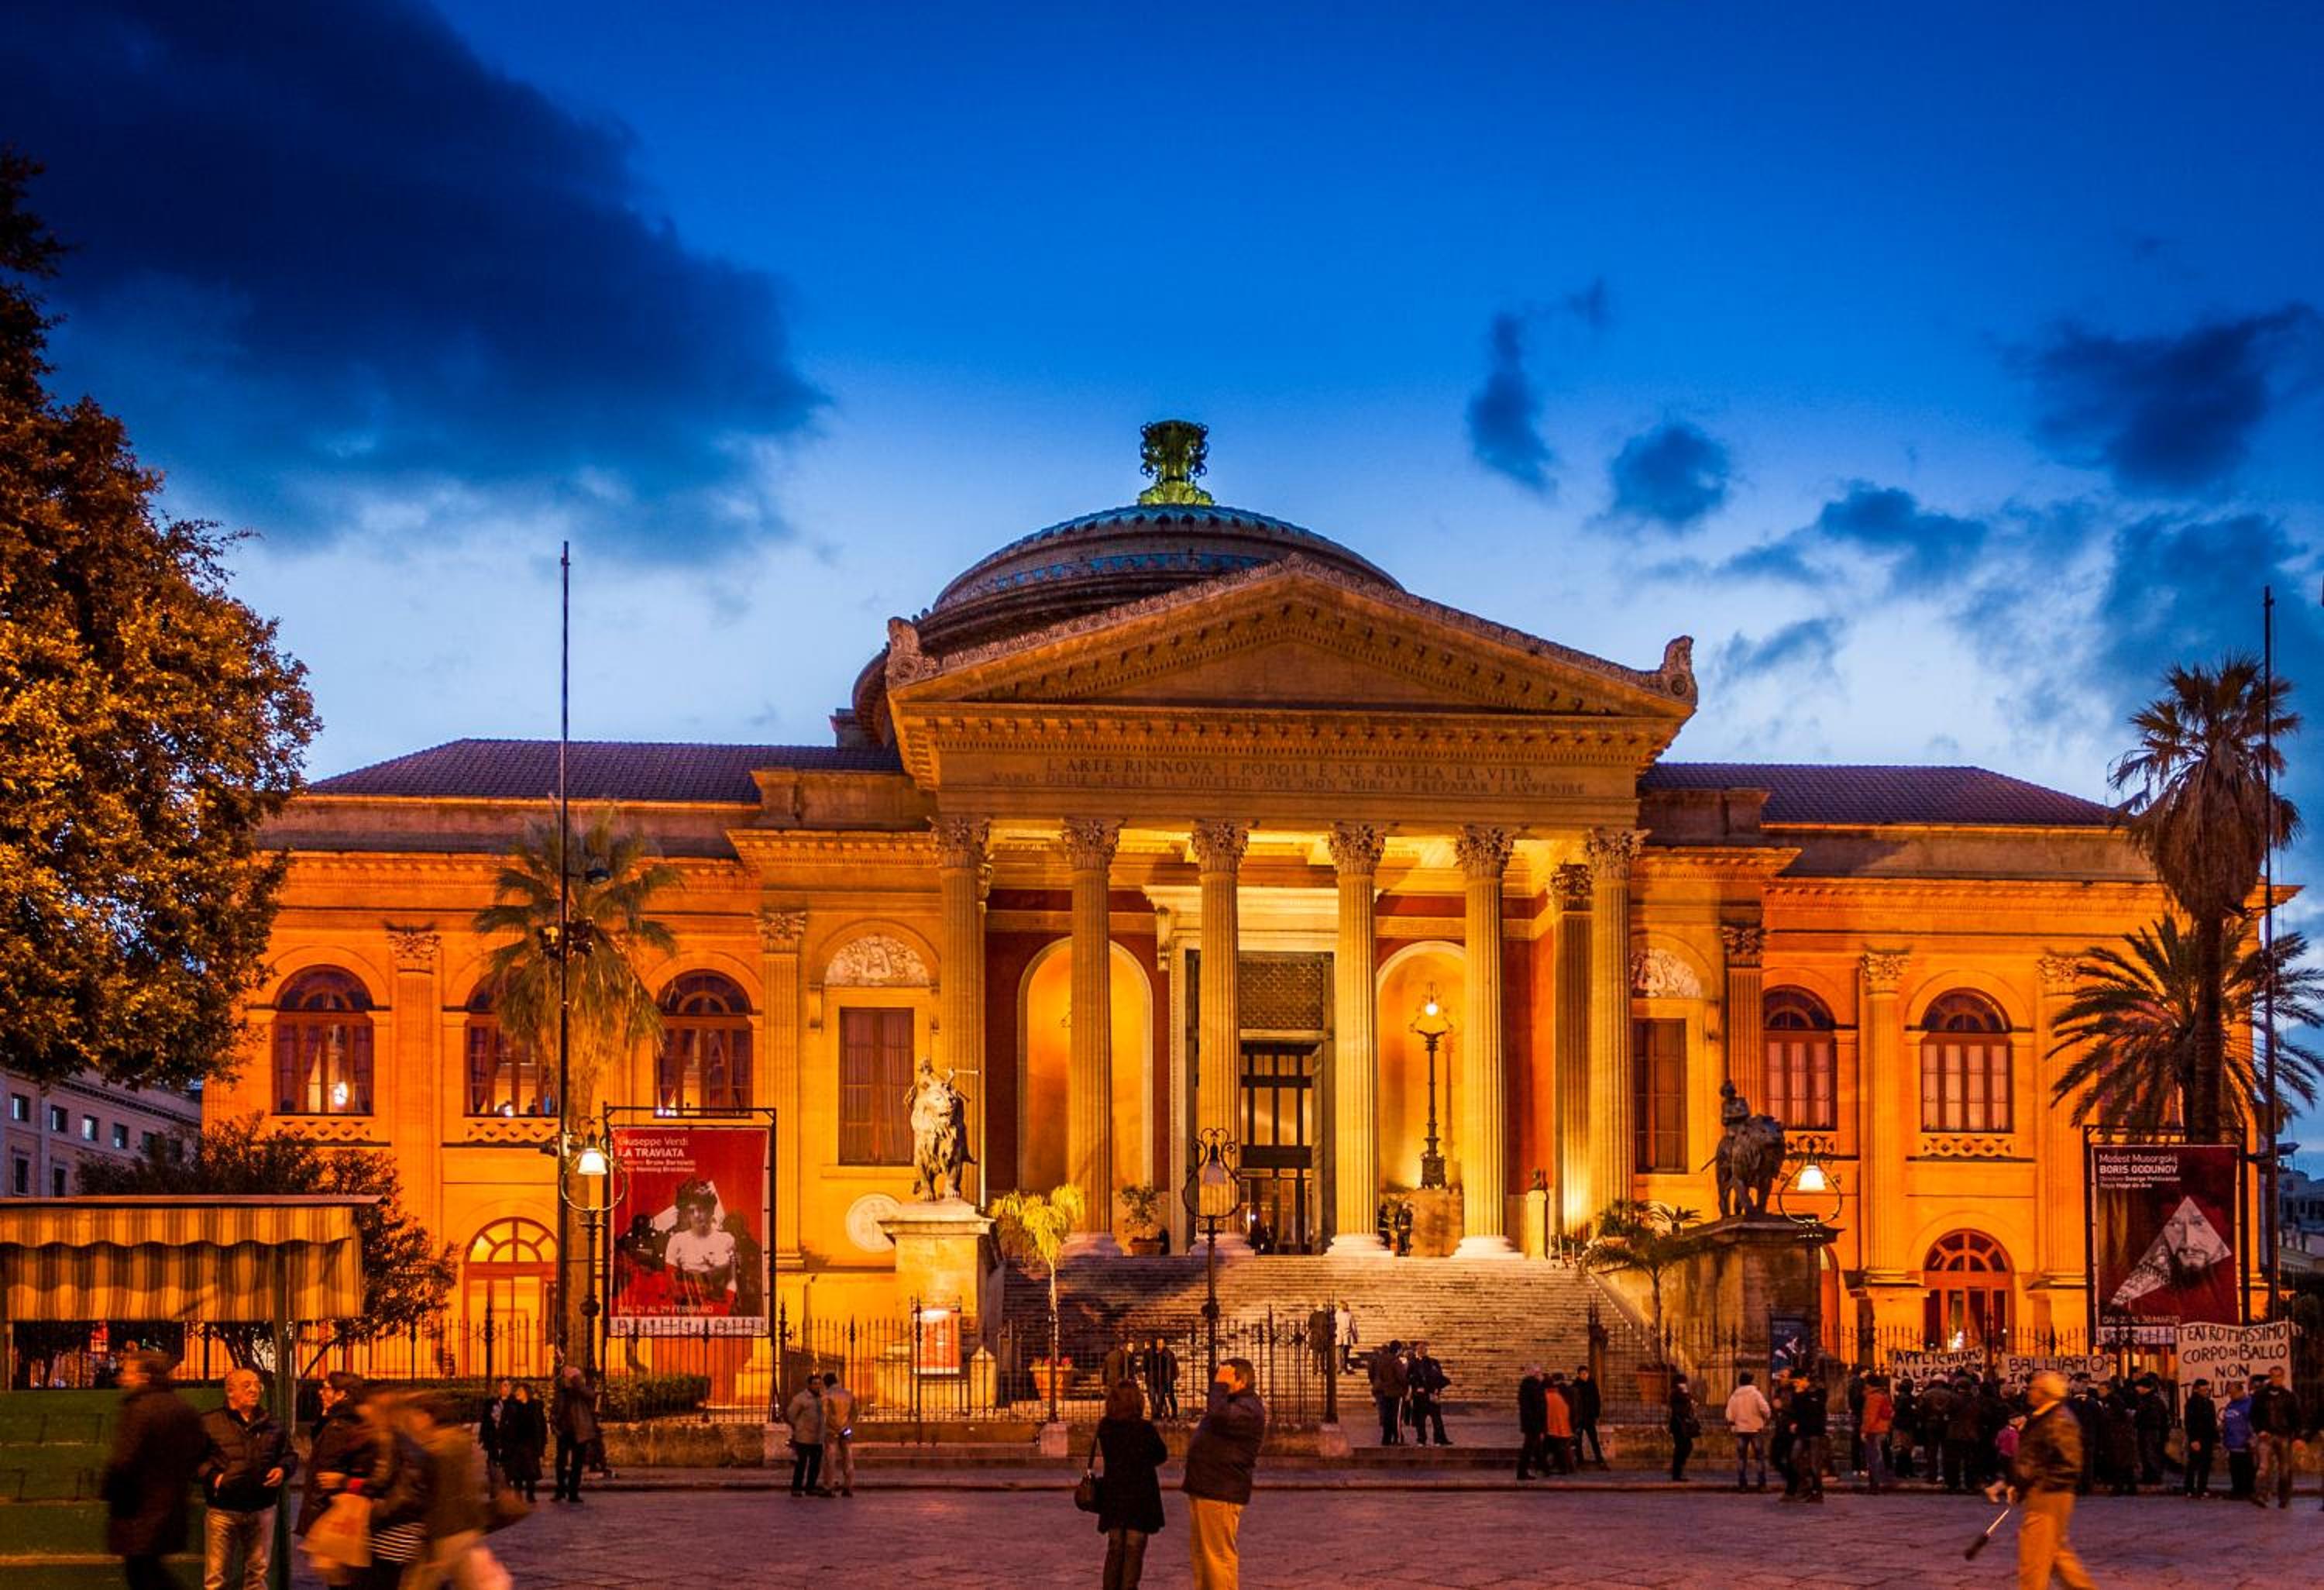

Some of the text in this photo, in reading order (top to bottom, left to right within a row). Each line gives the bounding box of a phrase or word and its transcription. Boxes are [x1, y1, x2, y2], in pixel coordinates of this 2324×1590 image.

[1125, 759, 1214, 774] RINNOVA
[1241, 762, 1308, 777] POPOLI
[1456, 766, 1475, 780] LA
[1487, 767, 1532, 782] VITA
[618, 1136, 689, 1147] Giuseppe Verdi
[618, 1148, 685, 1158] LA TRAVIATA
[2099, 1153, 2131, 1163] Modest
[2099, 1165, 2178, 1174] BORIS GODUNOV
[618, 1304, 634, 1314] DAL
[647, 1305, 658, 1314] AL
[671, 1305, 713, 1314] FEBBRAIO
[2178, 1324, 2226, 1342] TEATRO
[2226, 1323, 2288, 1343] MASSIMO
[2182, 1346, 2228, 1364] CORPO
[2238, 1344, 2288, 1361] BALLO
[2008, 1355, 2105, 1372] BALLIAMO
[2215, 1364, 2250, 1378] NON
